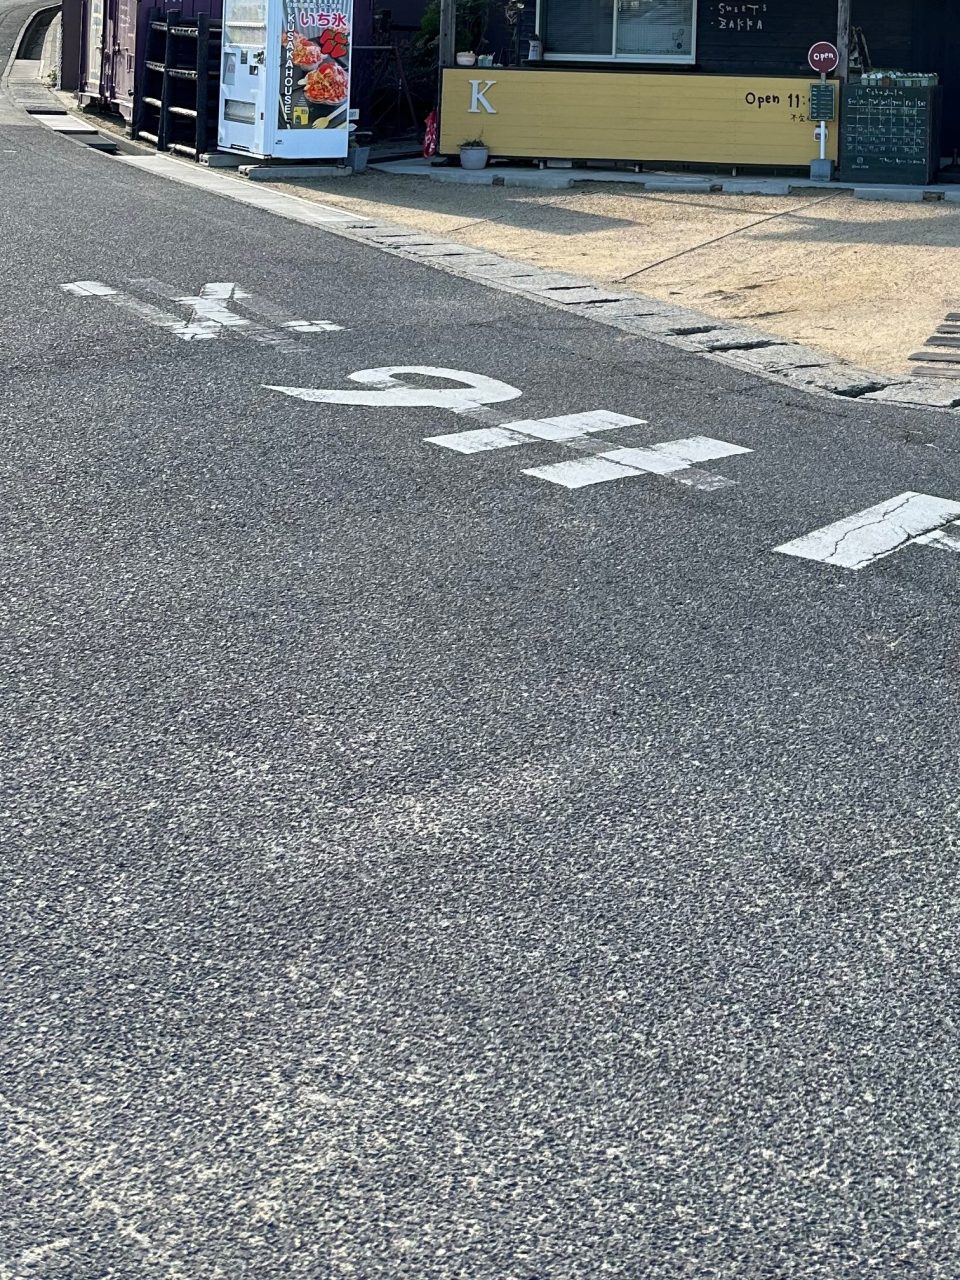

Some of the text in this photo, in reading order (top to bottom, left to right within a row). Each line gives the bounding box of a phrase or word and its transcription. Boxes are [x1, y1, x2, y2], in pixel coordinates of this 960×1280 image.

[300, 12, 347, 28] いち氷
[718, 17, 763, 31] ZAKKA
[284, 13, 295, 114] KUSAKAHOUSE
[467, 79, 497, 114] K
[745, 92, 780, 109] Open
[787, 93, 810, 108] 11:
